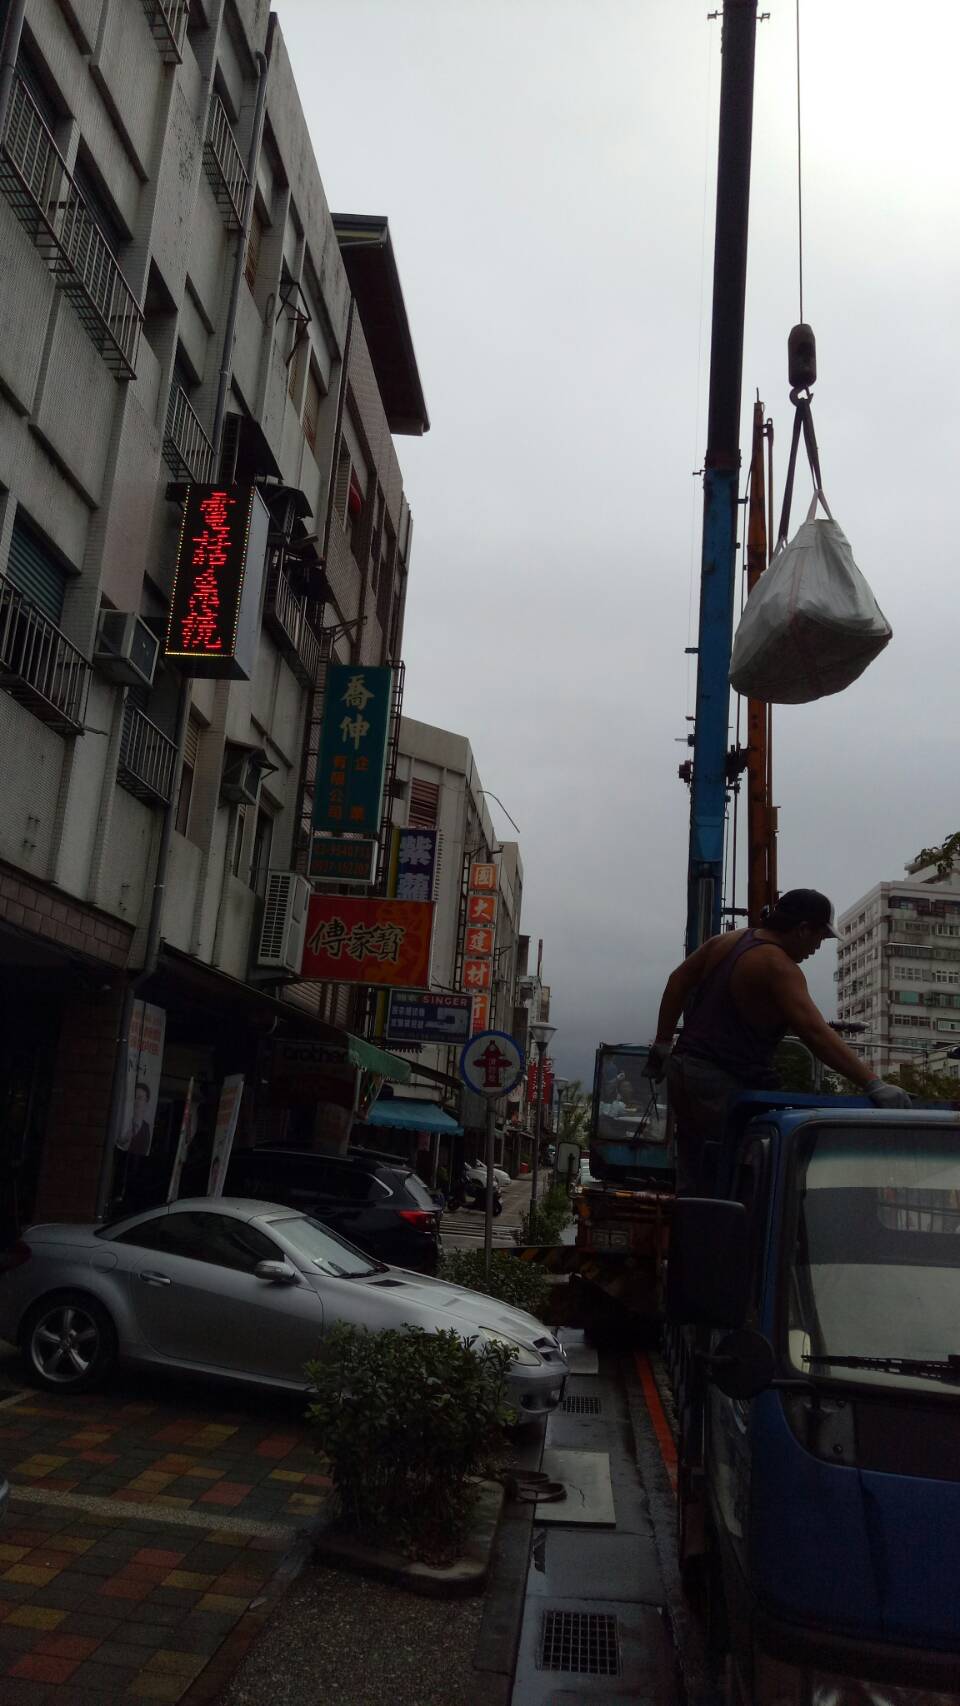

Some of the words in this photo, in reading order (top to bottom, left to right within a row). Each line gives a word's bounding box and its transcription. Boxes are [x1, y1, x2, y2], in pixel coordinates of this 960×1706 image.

[340, 673, 374, 751] 喬伸
[307, 916, 405, 962] 傳家寶
[423, 995, 468, 1007] SINGER
